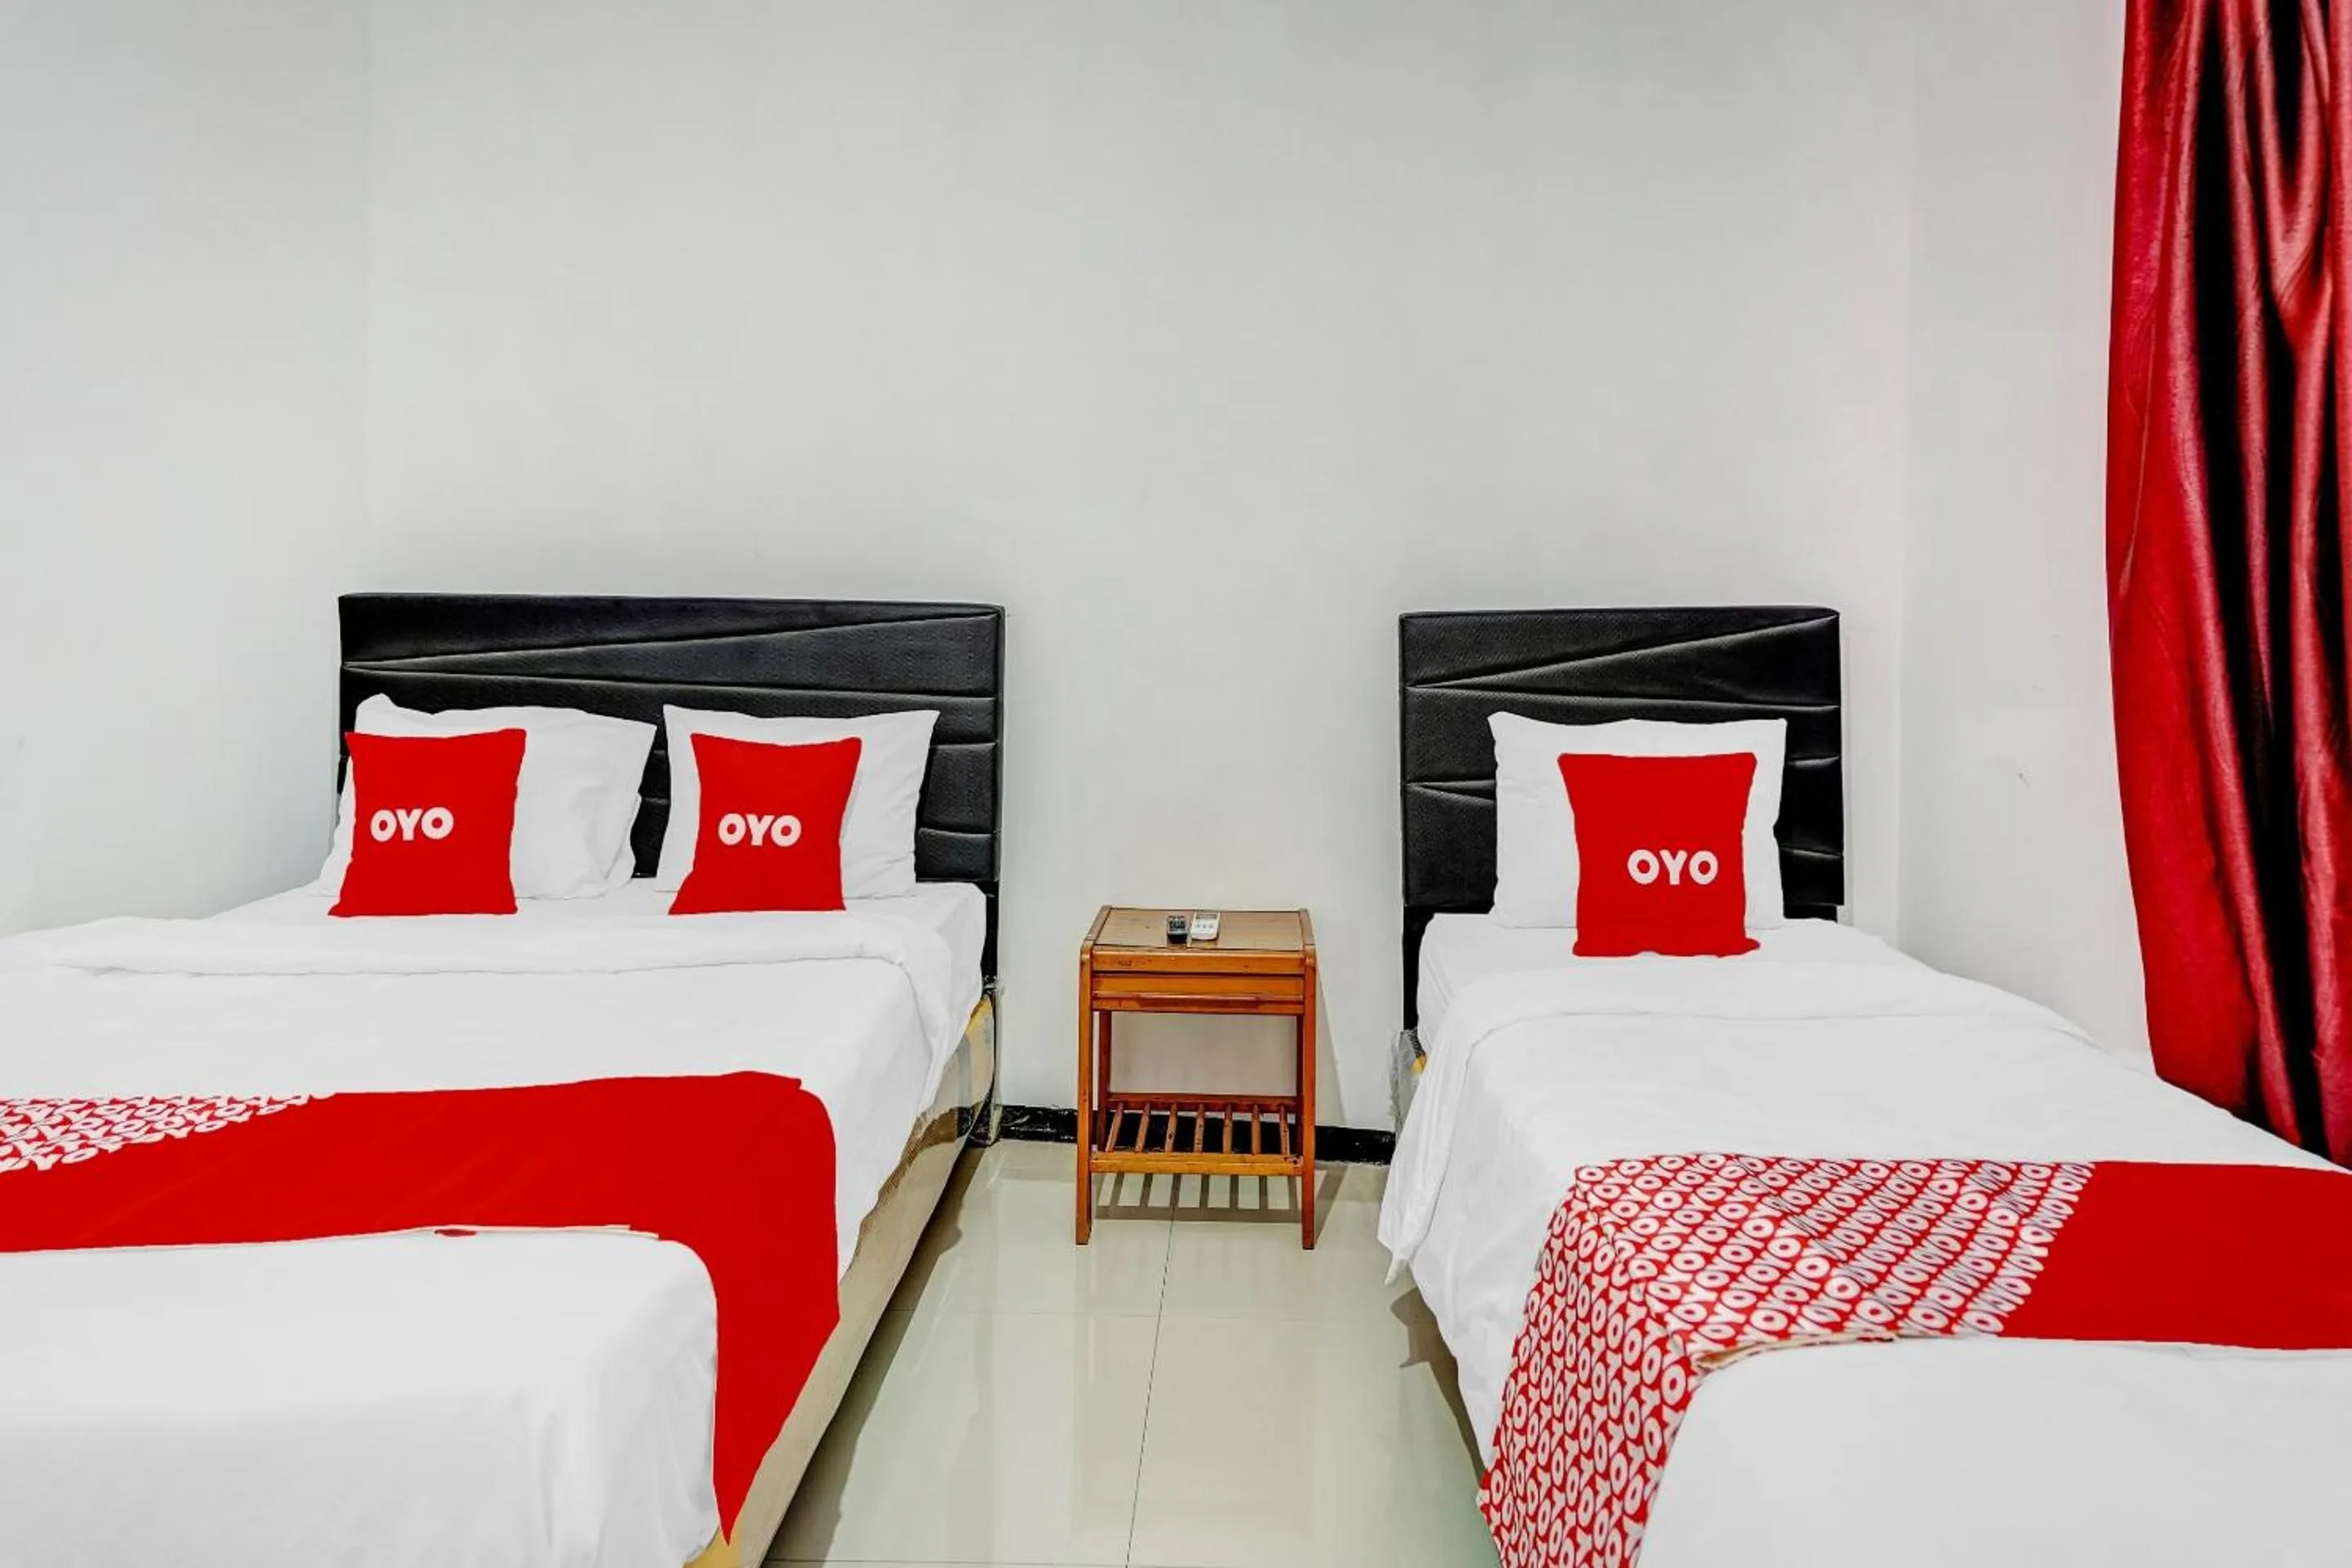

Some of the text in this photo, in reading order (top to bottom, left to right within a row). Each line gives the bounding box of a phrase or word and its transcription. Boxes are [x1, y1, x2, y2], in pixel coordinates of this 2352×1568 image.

[370, 807, 454, 842] OYO
[718, 813, 802, 847] OYO
[1627, 849, 1718, 885] OYO
